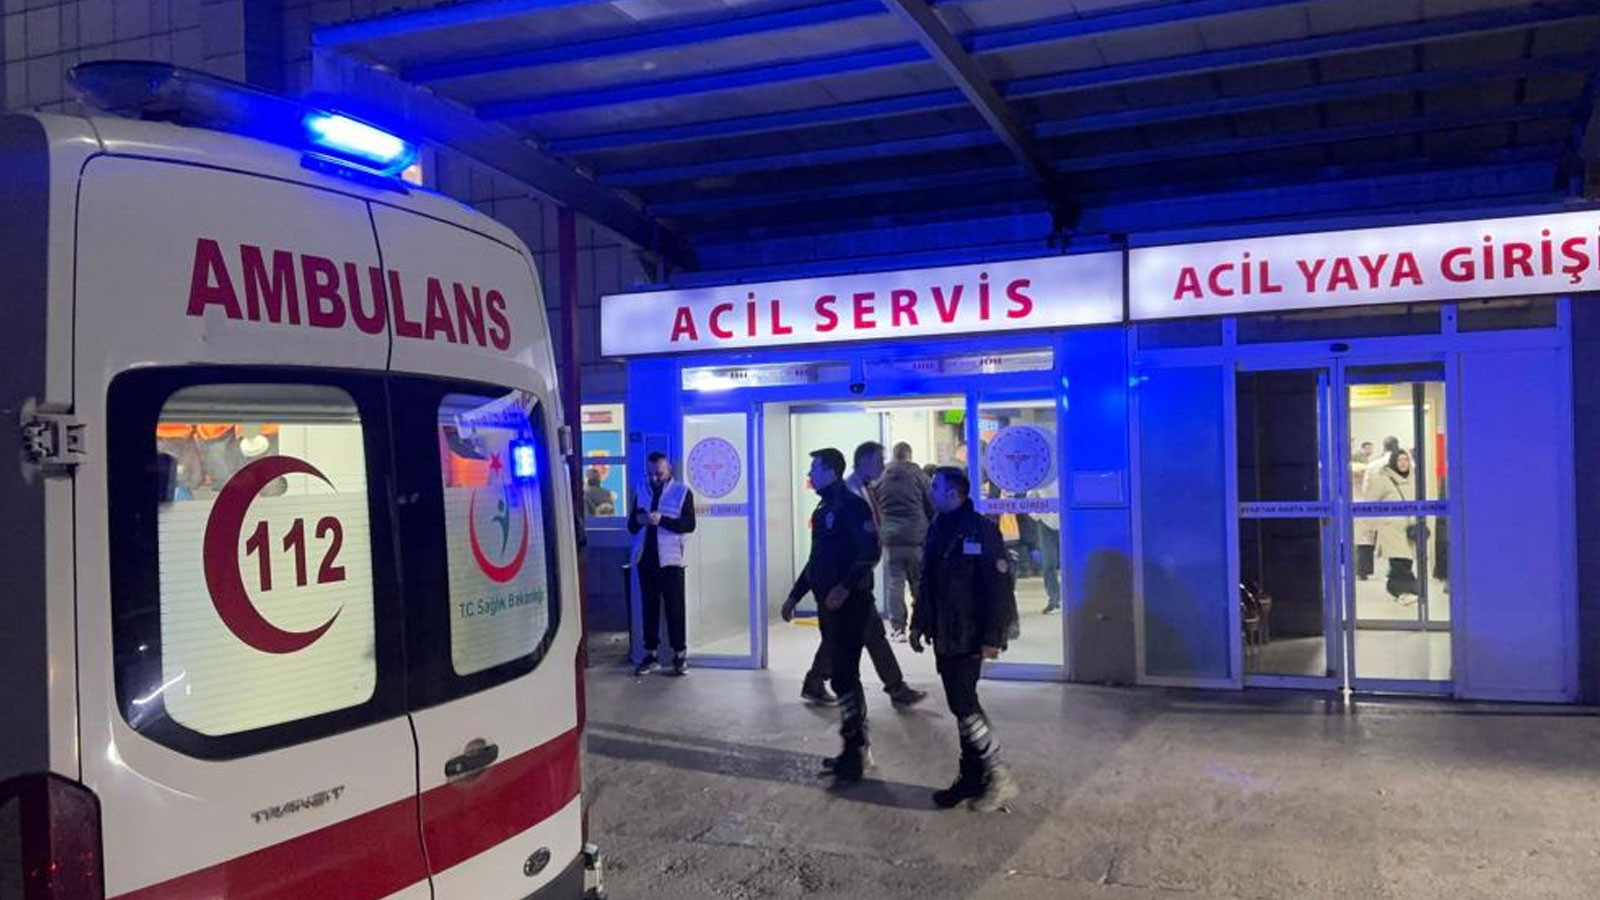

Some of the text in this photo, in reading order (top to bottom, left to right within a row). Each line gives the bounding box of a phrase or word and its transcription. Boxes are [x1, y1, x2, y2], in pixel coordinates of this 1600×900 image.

[186, 238, 511, 351] AMBULANS
[1173, 226, 1600, 301] ACİL YAYA GİRİŞ
[670, 272, 1034, 342] ACİL SERVİS
[246, 516, 346, 592] 112
